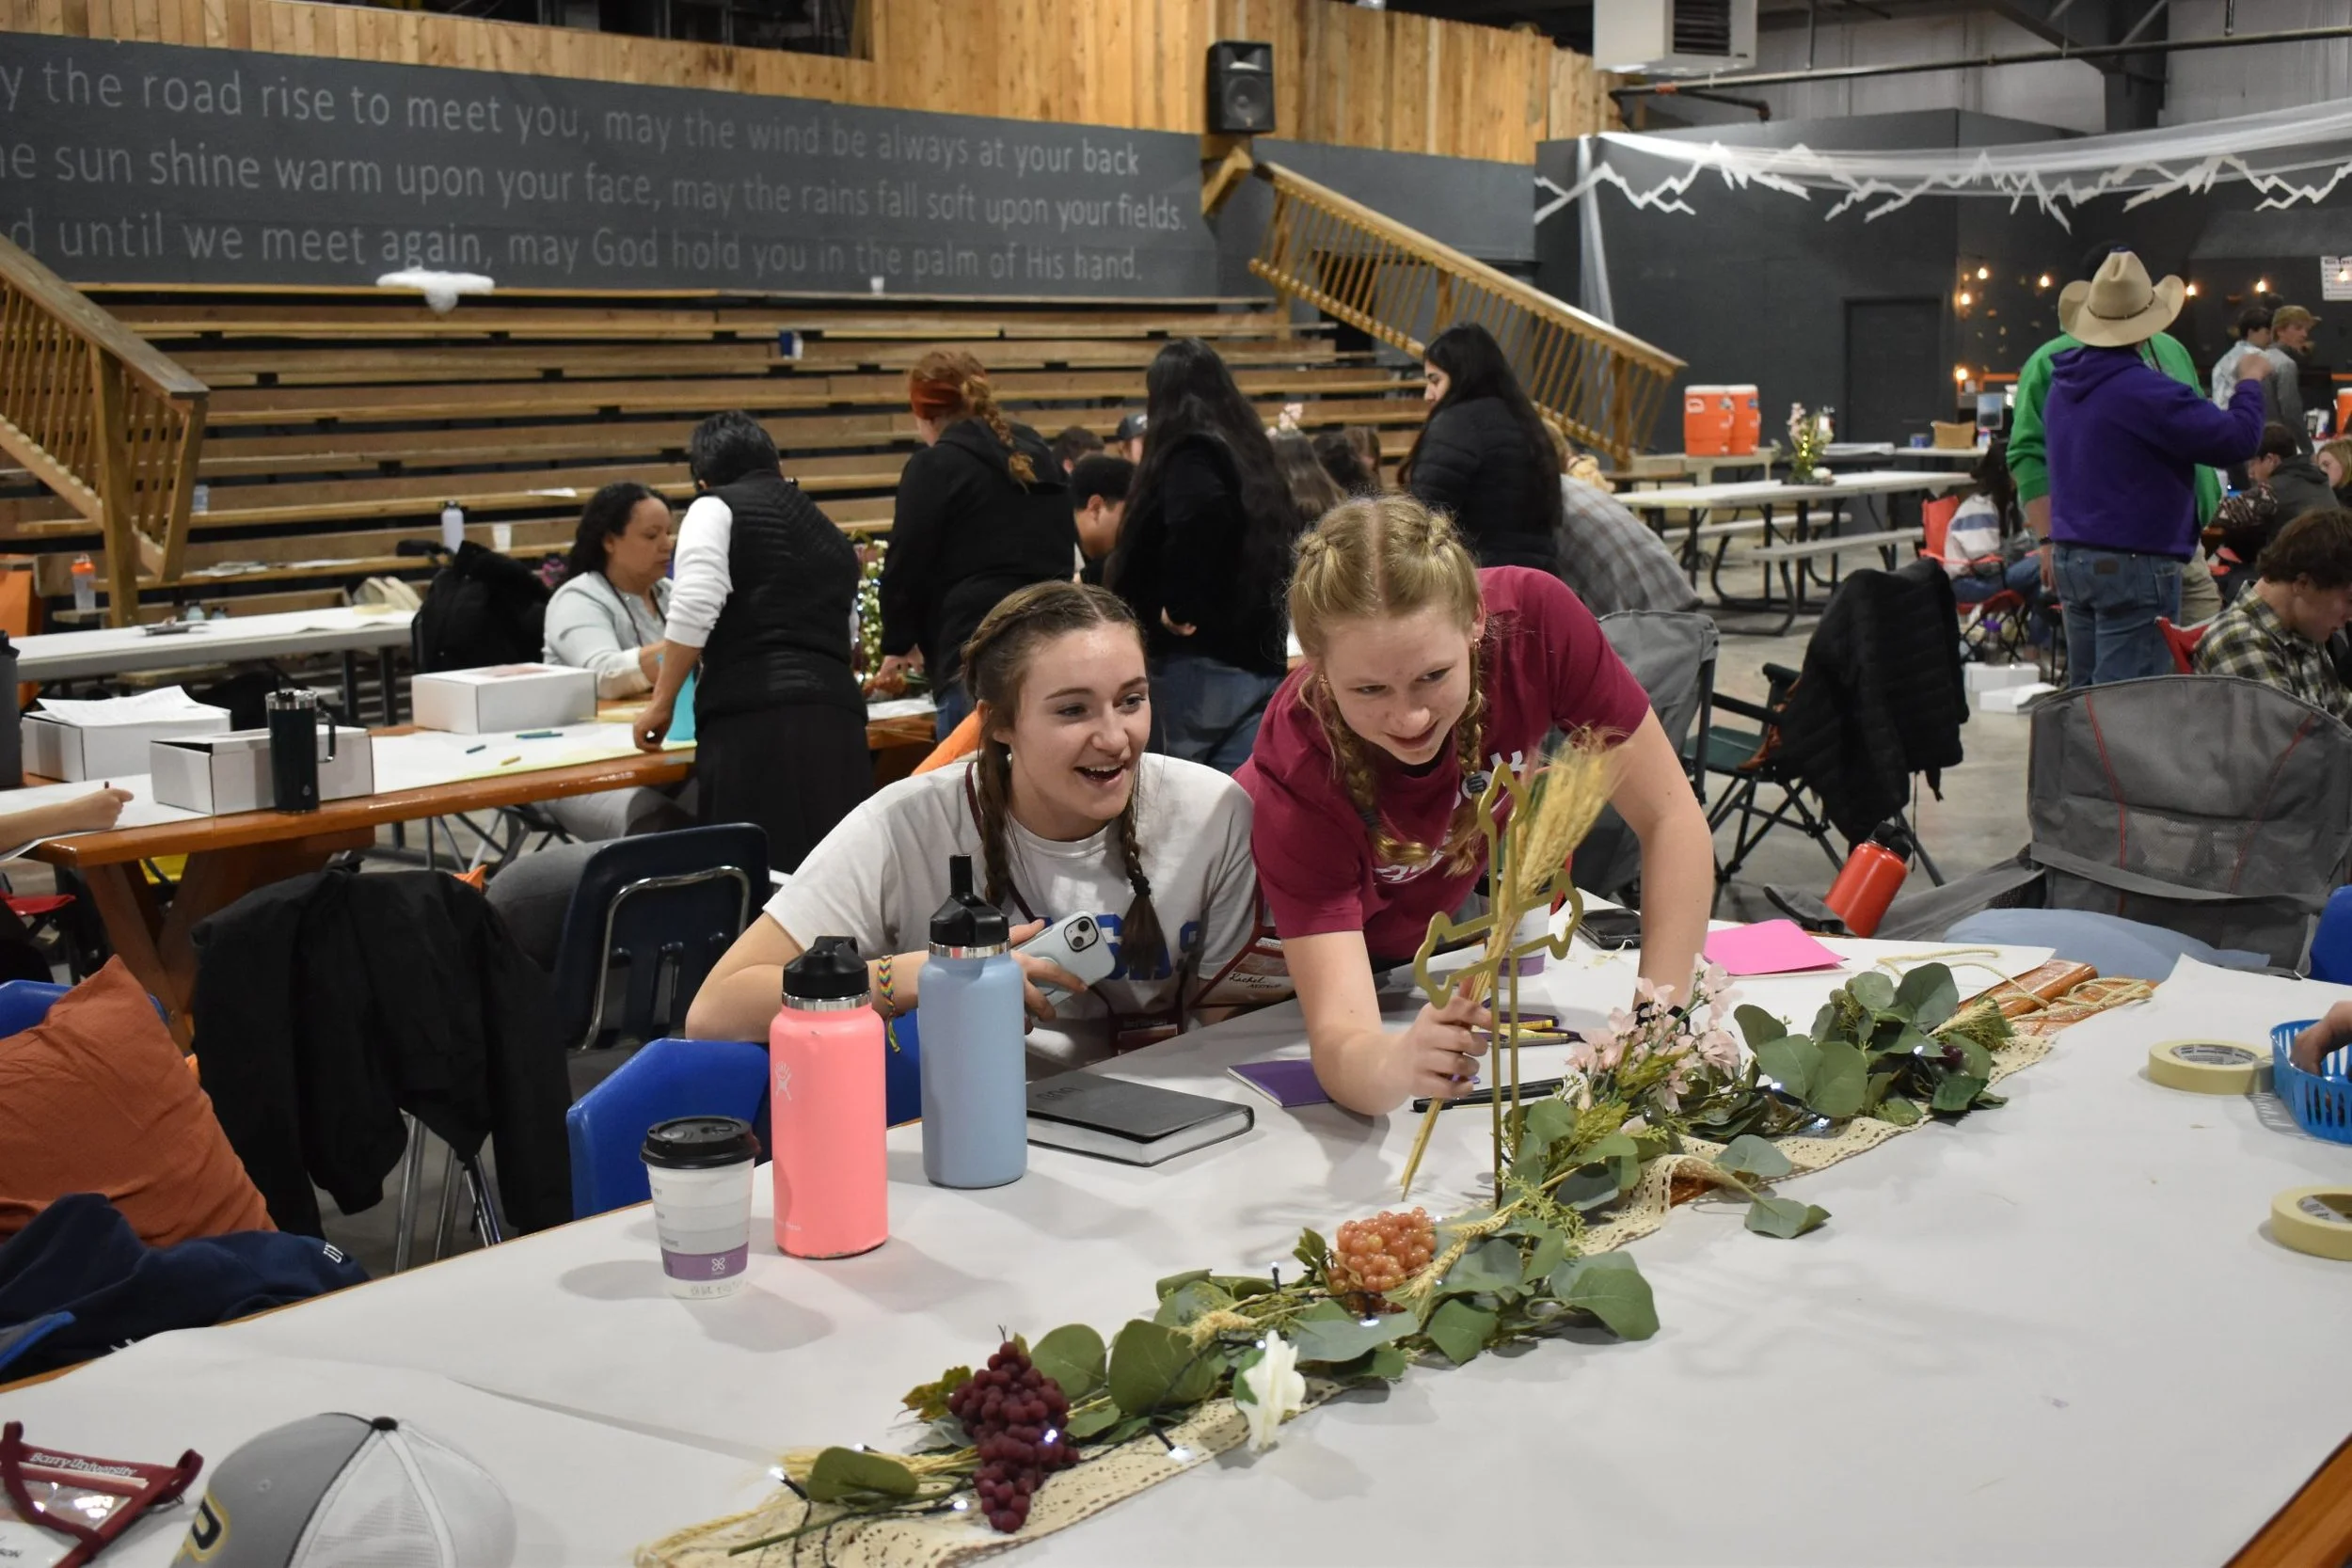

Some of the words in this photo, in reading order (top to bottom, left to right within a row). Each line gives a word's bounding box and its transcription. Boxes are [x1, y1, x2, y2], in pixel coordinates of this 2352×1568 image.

[42, 57, 122, 108] the
[143, 71, 242, 116] road
[262, 76, 335, 122] rise
[350, 87, 389, 126] to
[407, 95, 501, 134] meet
[515, 104, 589, 145] you,
[605, 111, 672, 153] may
[684, 109, 735, 150] the
[748, 117, 820, 155] wind
[832, 120, 866, 159] be
[878, 126, 968, 167] always
[979, 139, 1004, 167] at
[1014, 145, 1073, 178] your
[1083, 139, 1138, 176] back
[55, 146, 133, 183] sun
[150, 138, 261, 189] shine
[275, 158, 382, 192] warm
[396, 164, 485, 205] upon
[497, 169, 573, 209] your
[584, 162, 660, 211] face,
[672, 179, 735, 216] may
[742, 173, 792, 214] the
[801, 178, 869, 216] rains
[877, 179, 917, 217] fall
[927, 184, 976, 221] soft
[986, 198, 1049, 230] upon
[1057, 199, 1112, 232] your
[1117, 193, 1186, 231] fields.
[59, 210, 163, 257] until
[183, 226, 243, 260] we
[262, 228, 365, 265] meet
[380, 223, 492, 270] again,
[509, 234, 579, 274] may
[592, 226, 658, 267] God
[673, 230, 739, 270] hold
[754, 245, 806, 277] you
[818, 238, 845, 273] in
[856, 238, 900, 275] the
[914, 242, 978, 282] palm
[990, 241, 1017, 279] of
[1027, 245, 1064, 279] His
[1074, 244, 1142, 281] hand.
